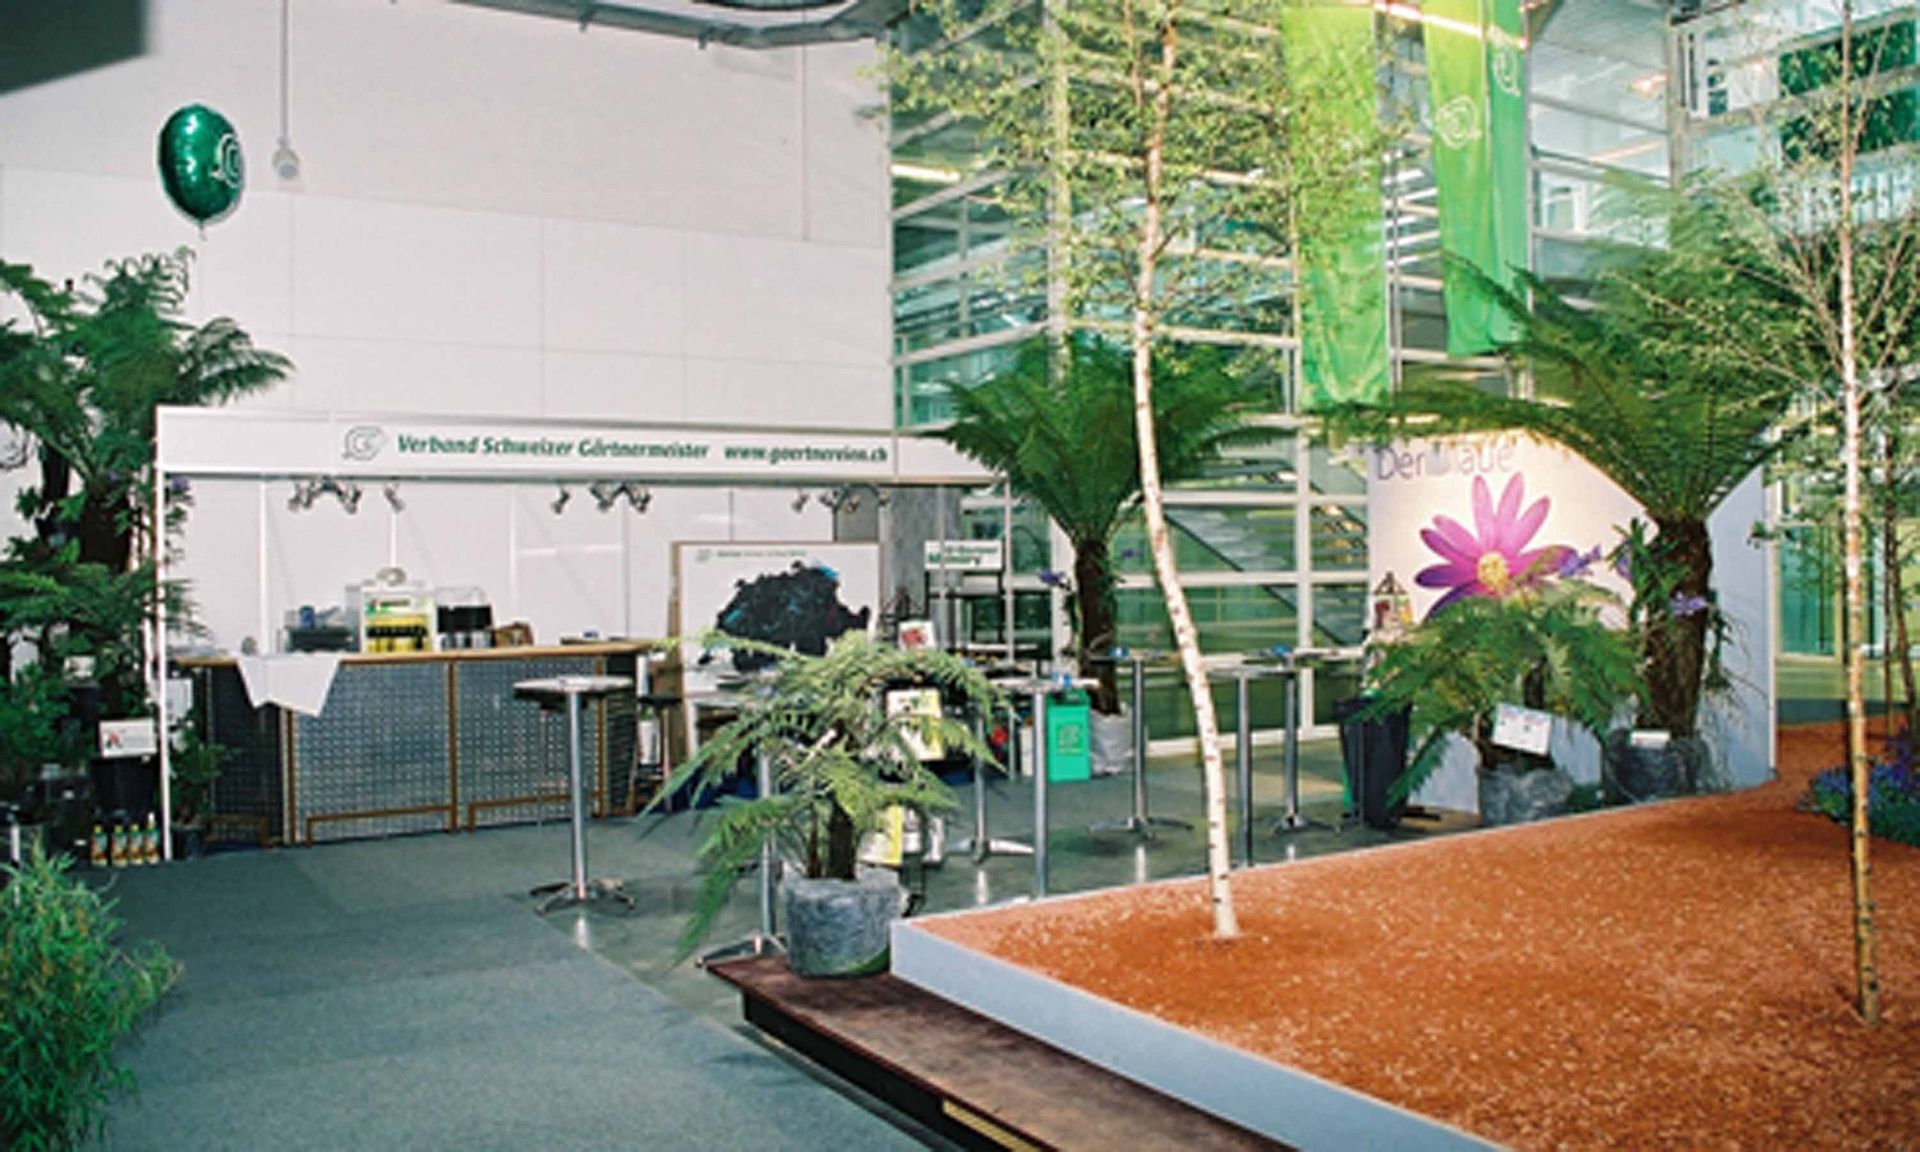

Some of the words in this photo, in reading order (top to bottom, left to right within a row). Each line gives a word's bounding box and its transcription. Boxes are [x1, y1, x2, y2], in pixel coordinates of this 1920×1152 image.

[397, 433, 479, 454] Verband
[482, 436, 573, 458] Schweizer
[1375, 447, 1426, 480] Der
